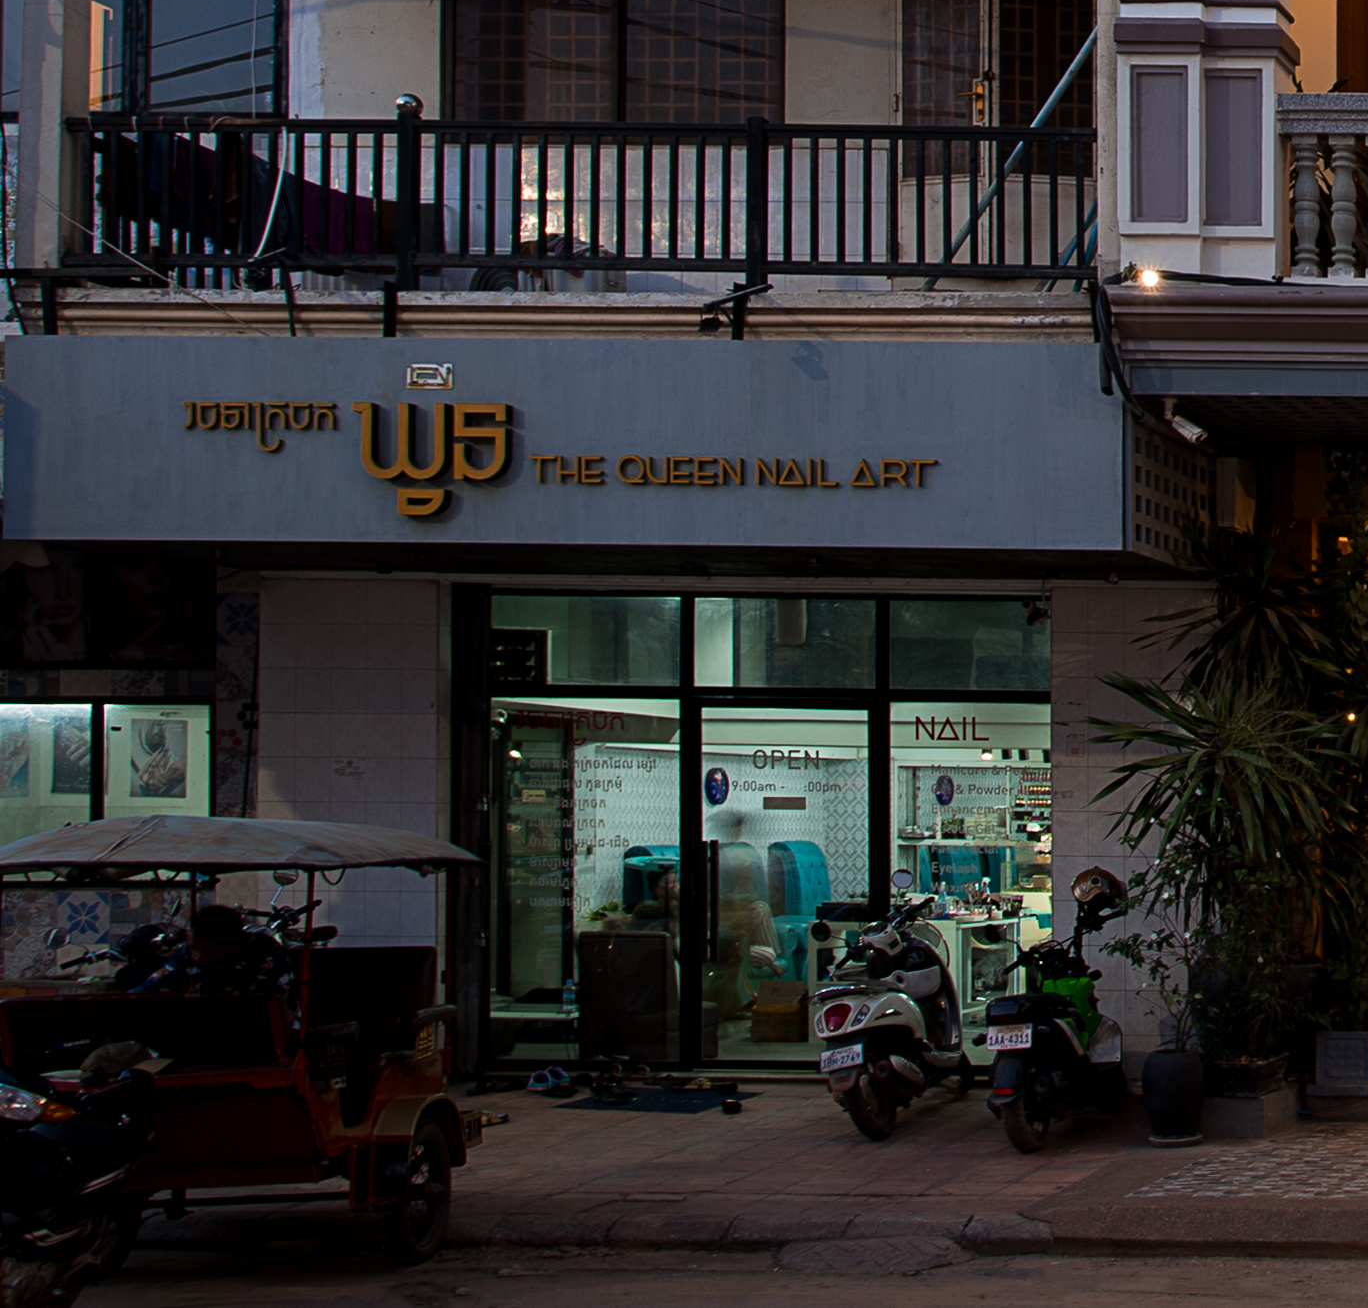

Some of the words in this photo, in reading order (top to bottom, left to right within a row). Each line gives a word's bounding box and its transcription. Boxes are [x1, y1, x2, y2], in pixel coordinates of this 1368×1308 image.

[529, 455, 605, 485] THE
[616, 455, 743, 486] QUEEN
[755, 457, 839, 487] NAIL
[848, 458, 938, 488] ART
[915, 715, 990, 741] NAIL
[752, 749, 821, 771] OPEN
[930, 764, 989, 776] Manicure
[731, 780, 777, 793] 9:00am
[968, 784, 1015, 796] Powder
[930, 861, 979, 876] Eyelash
[988, 1031, 1030, 1046] 1AA-4311
